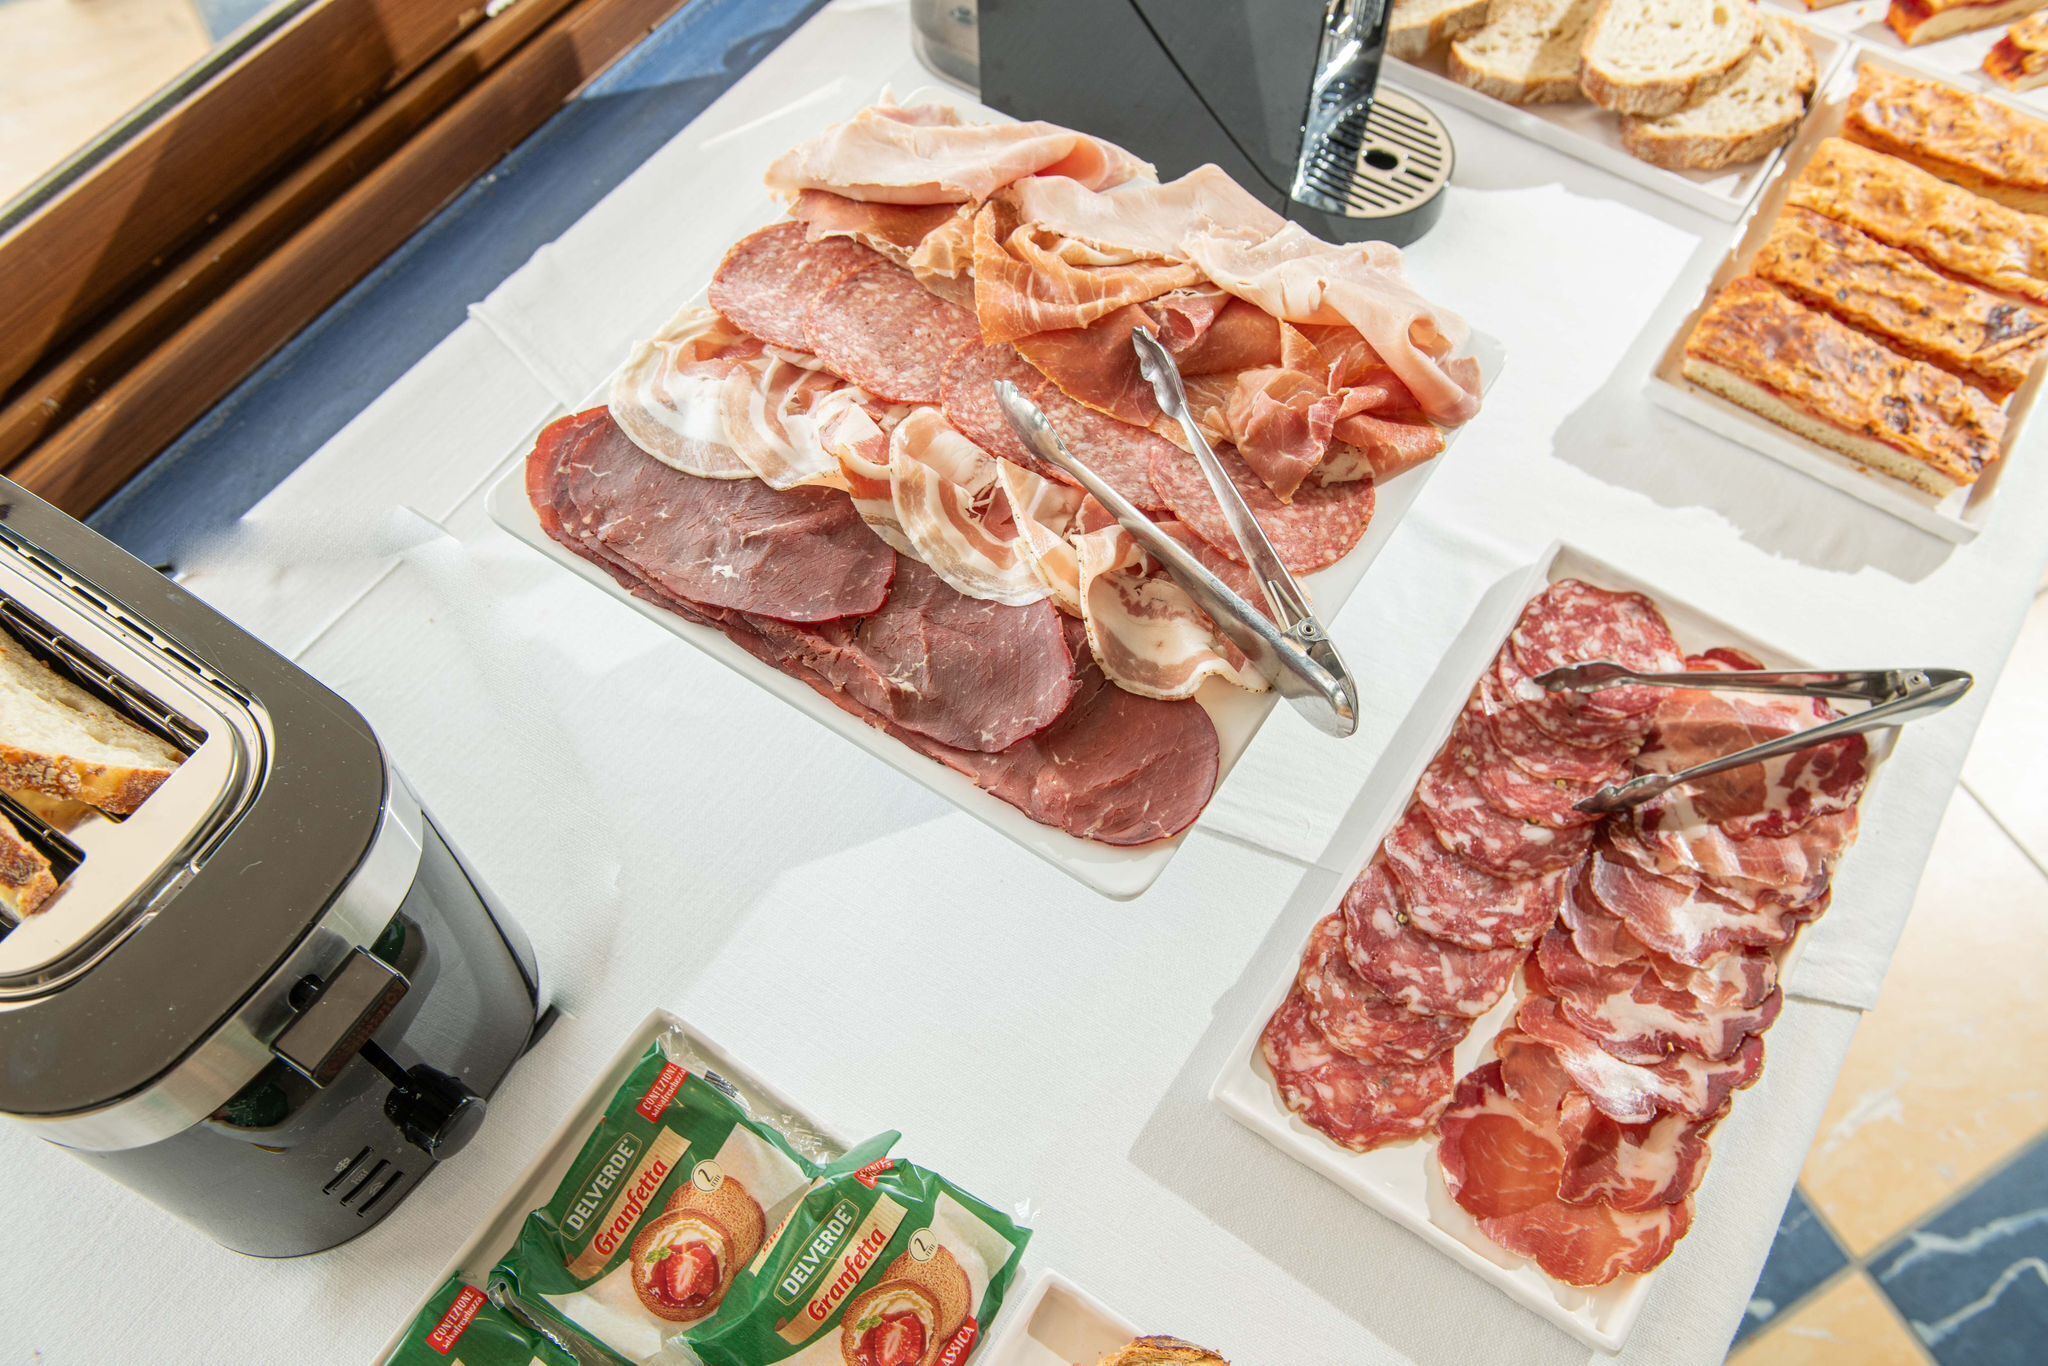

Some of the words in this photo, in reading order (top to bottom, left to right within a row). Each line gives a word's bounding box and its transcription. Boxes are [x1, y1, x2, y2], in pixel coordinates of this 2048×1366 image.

[641, 1063, 678, 1111] CONFEZIONE
[566, 1138, 635, 1231] DELVERDE
[698, 1168, 714, 1183] 2
[592, 1159, 668, 1256] Granfetta
[782, 1203, 853, 1296] DELVERDE
[914, 1237, 929, 1252] 2
[808, 1227, 887, 1321] Granfetta
[433, 1289, 475, 1342] CONFEZIONE
[442, 1295, 484, 1351] salvafreschezza
